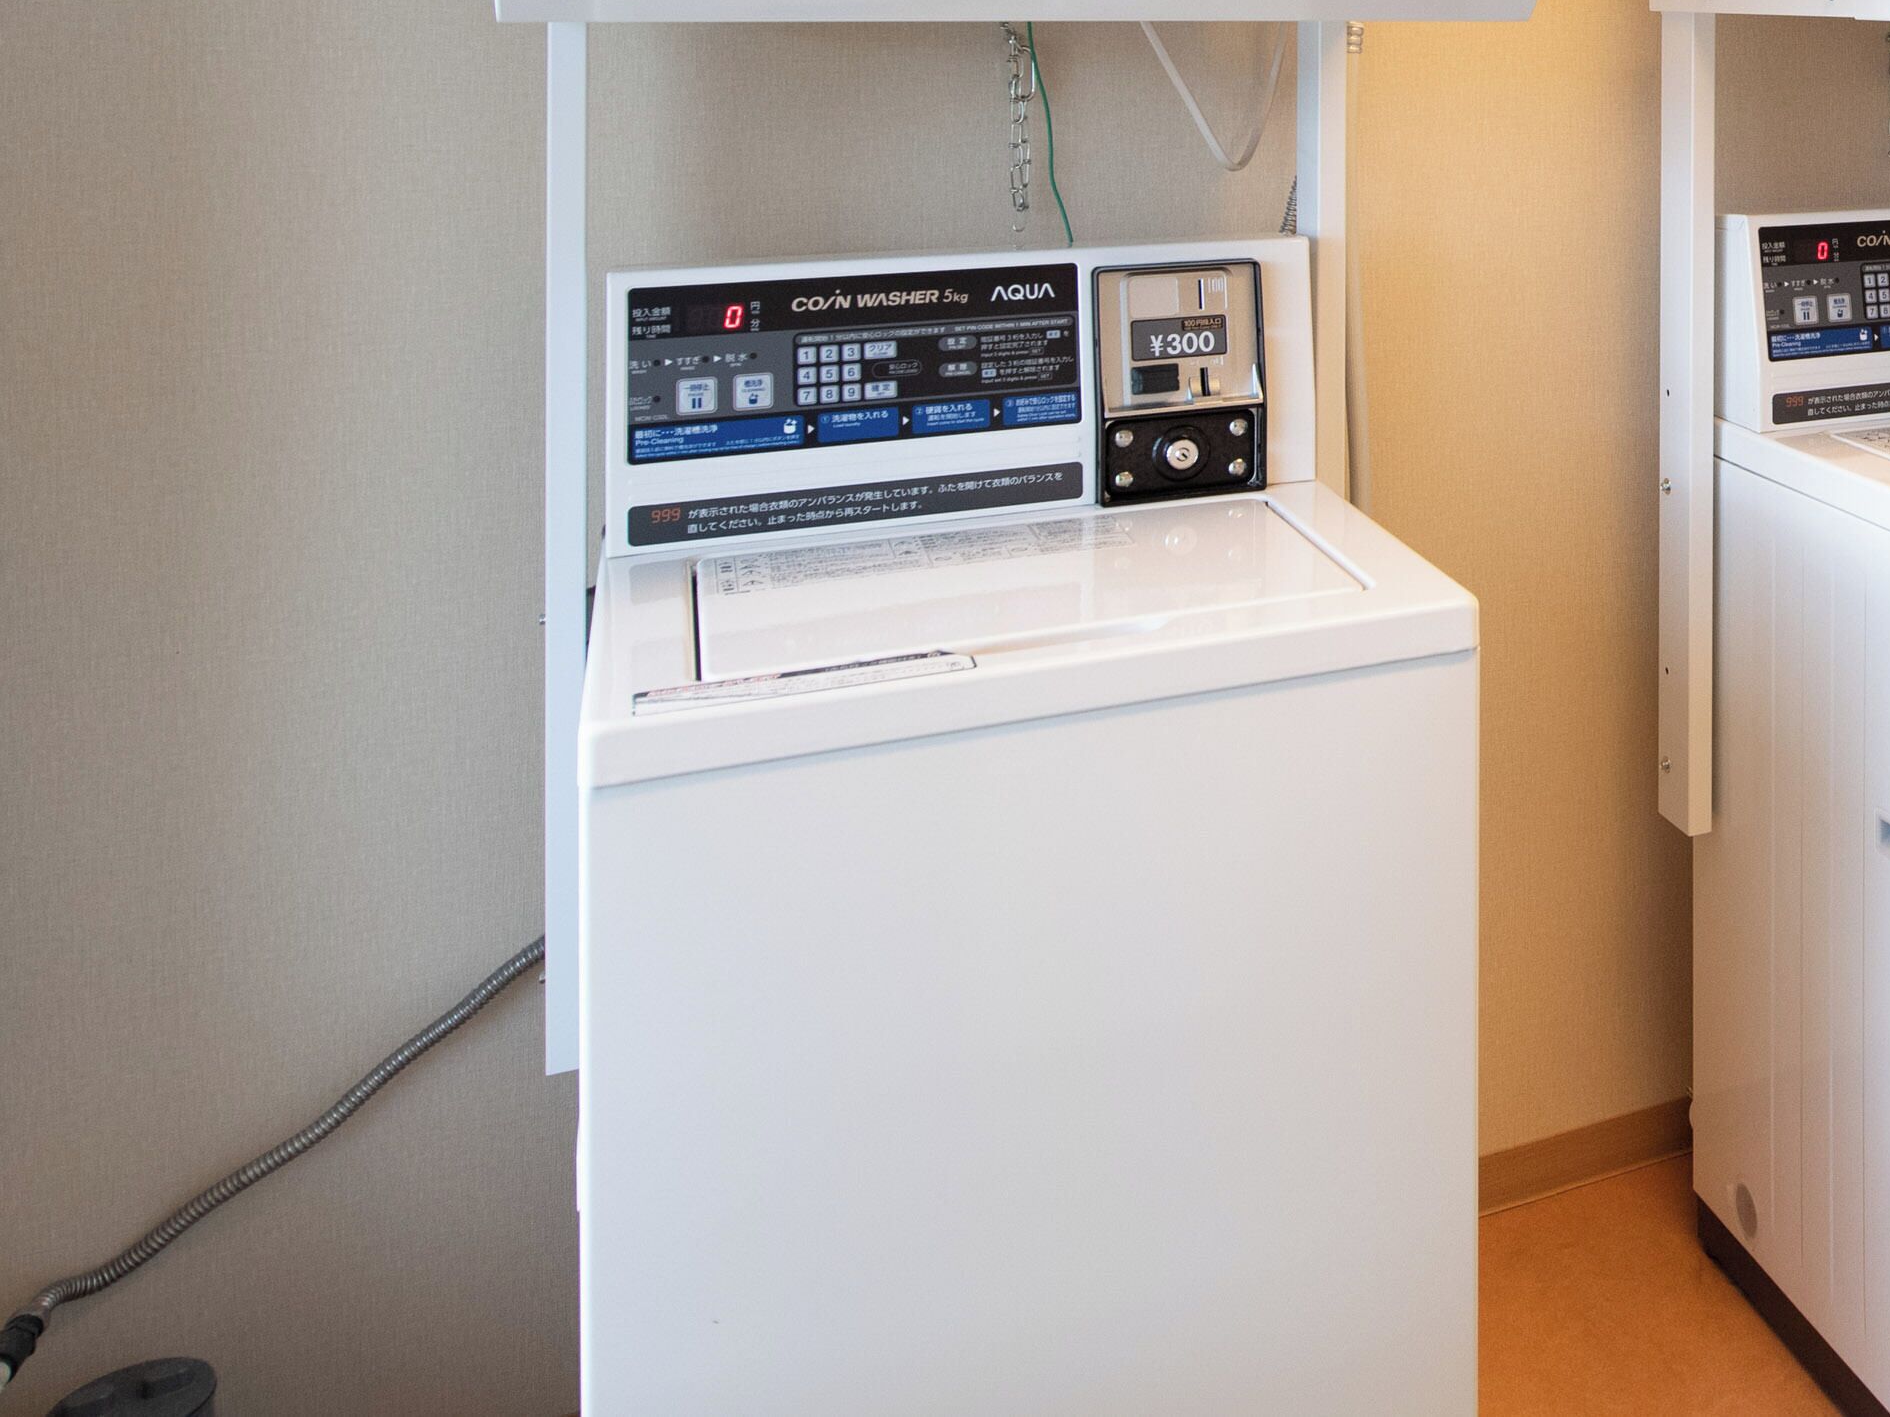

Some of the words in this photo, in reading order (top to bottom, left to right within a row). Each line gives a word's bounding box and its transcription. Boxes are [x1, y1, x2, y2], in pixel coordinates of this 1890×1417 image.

[1817, 242, 1828, 260] 0
[991, 282, 1056, 303] AQUA
[857, 289, 939, 308] WASHER
[943, 289, 969, 305] 5kg
[632, 306, 671, 317] 投入金額
[724, 306, 743, 328] 0
[632, 324, 671, 335] 残り時間
[1150, 330, 1215, 357] ¥300
[804, 351, 809, 360] 1
[826, 349, 832, 358] 2
[848, 347, 855, 357] 3
[803, 371, 810, 380] 4
[826, 369, 832, 378] 5
[848, 367, 855, 377] 6
[803, 391, 810, 400] 7
[825, 389, 833, 399] 8
[848, 387, 855, 397] 9
[832, 410, 888, 422] 洗濯物を入れる
